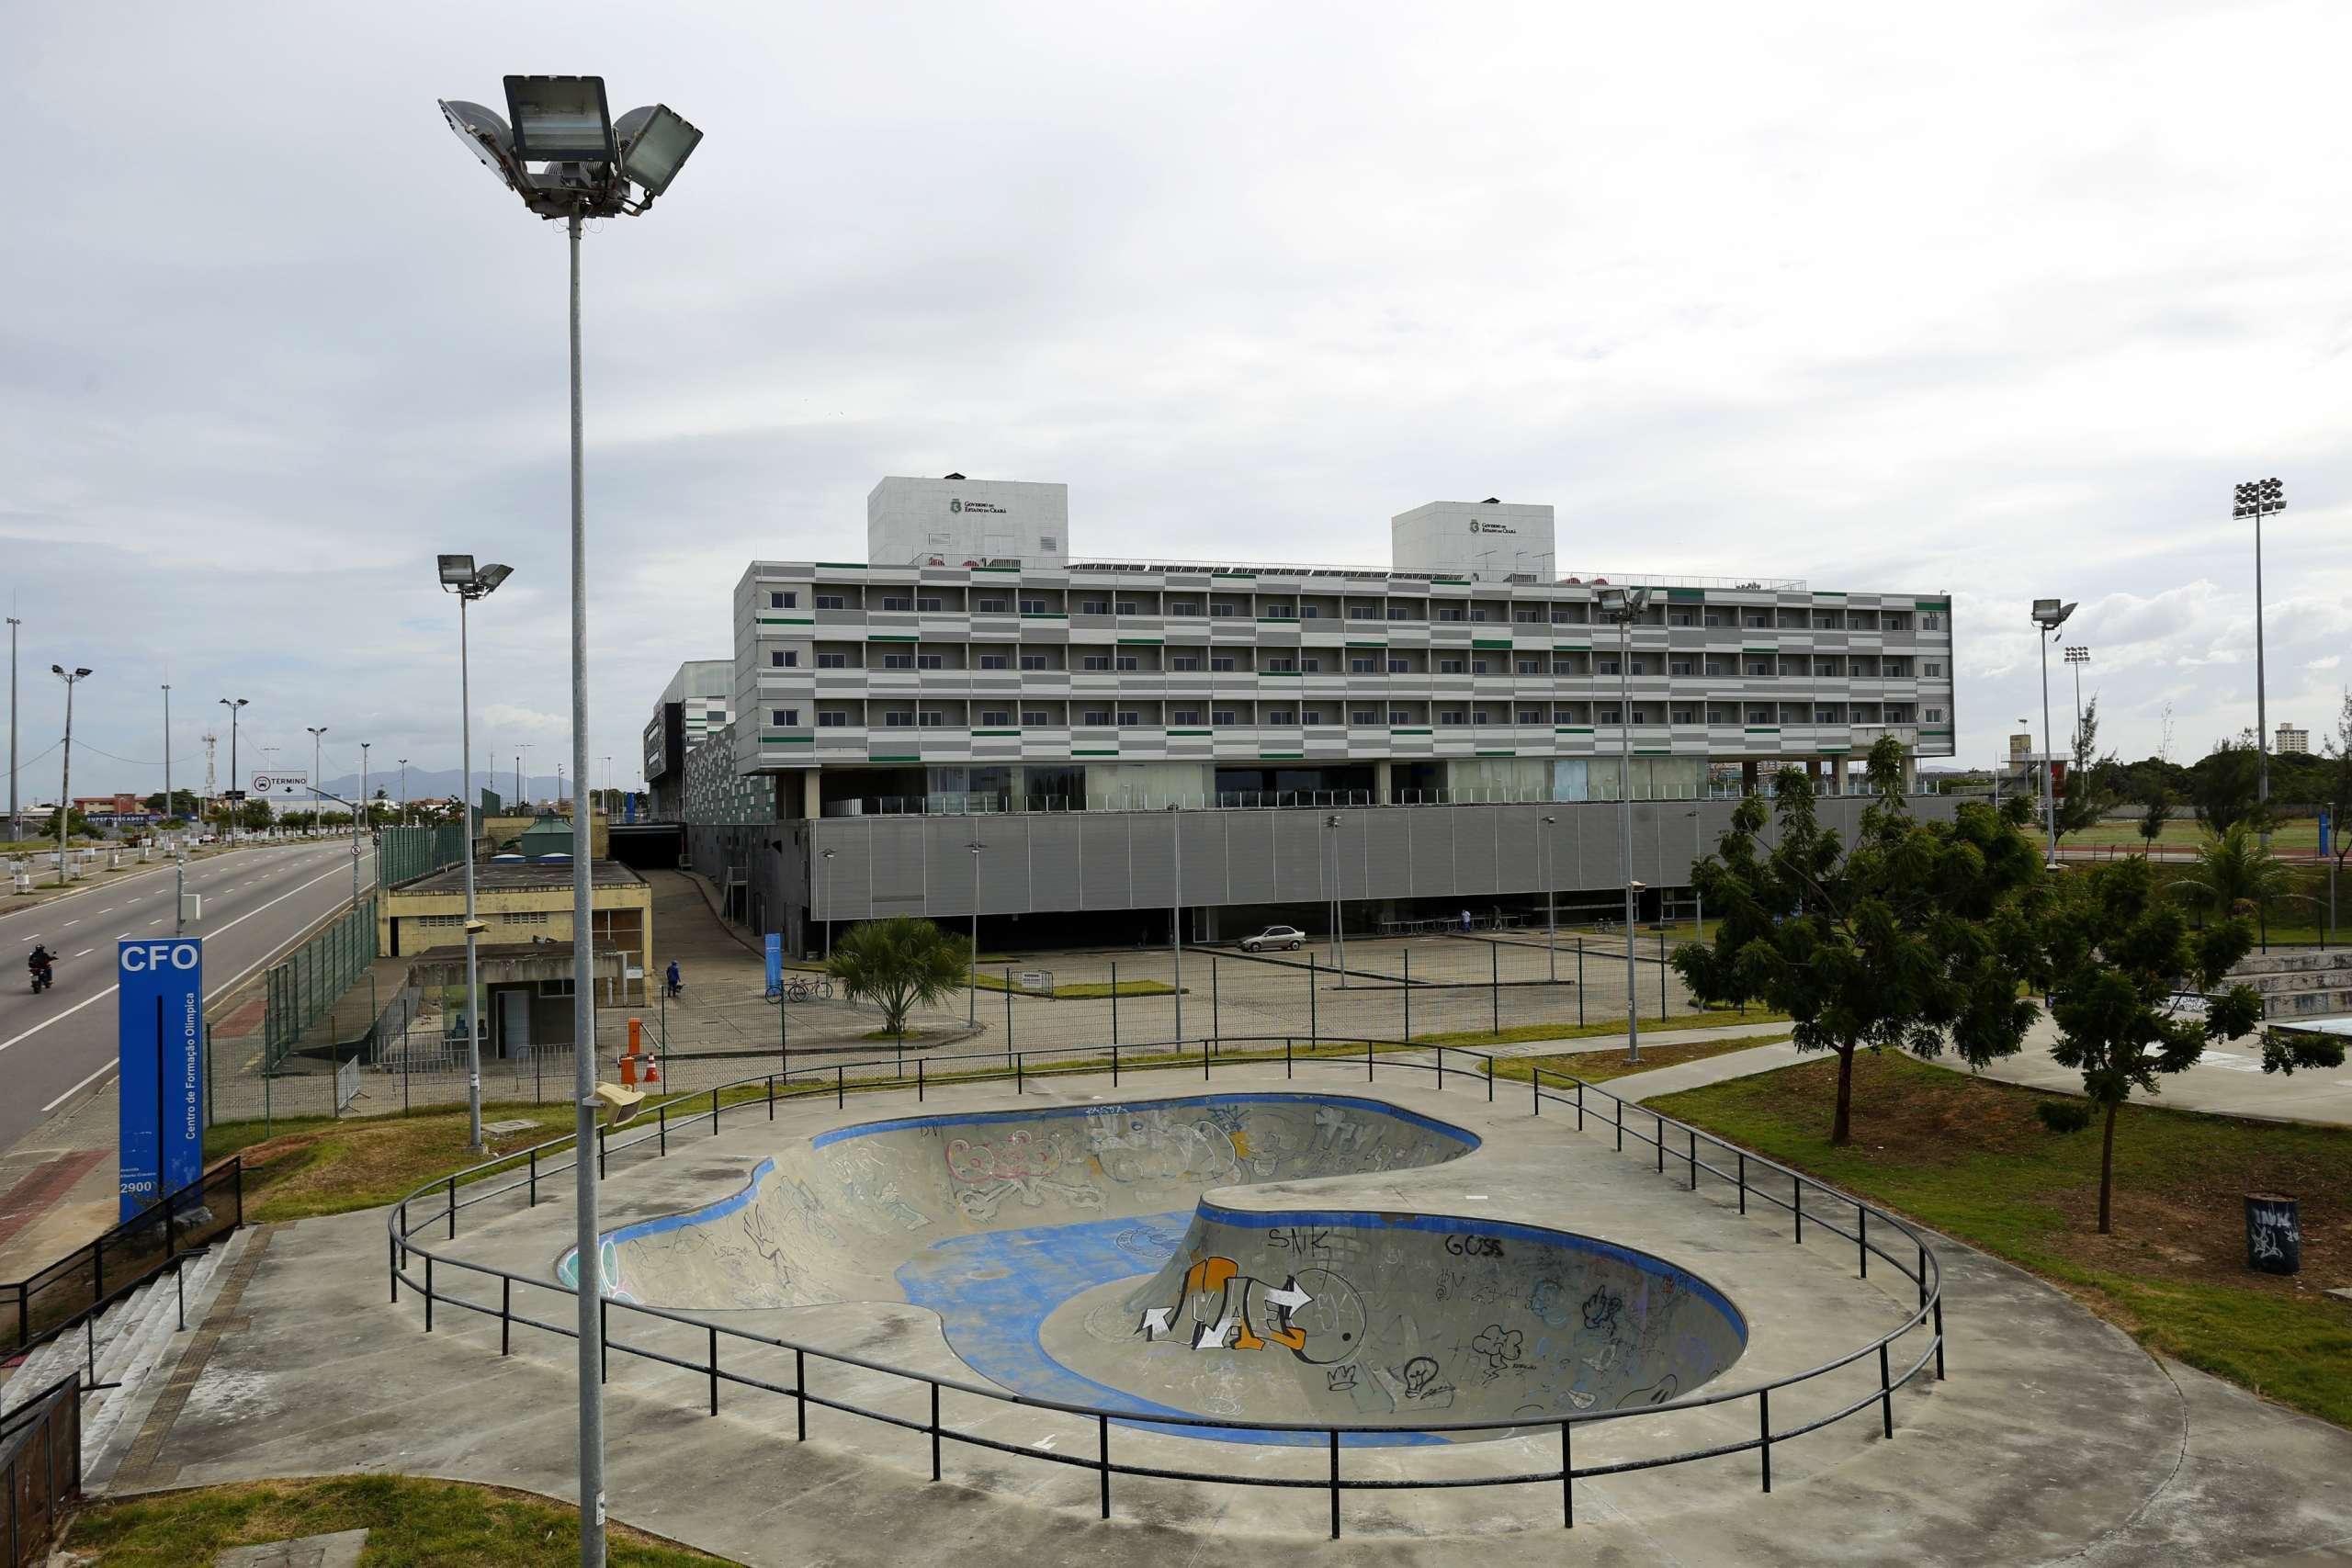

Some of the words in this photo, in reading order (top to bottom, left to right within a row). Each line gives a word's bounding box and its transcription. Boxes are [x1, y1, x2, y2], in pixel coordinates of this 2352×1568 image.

[120, 944, 198, 972] CFO
[186, 1039, 197, 1089] Formação
[186, 1091, 196, 1103] de
[186, 1105, 196, 1140] Centro
[120, 1181, 152, 1193] 2900
